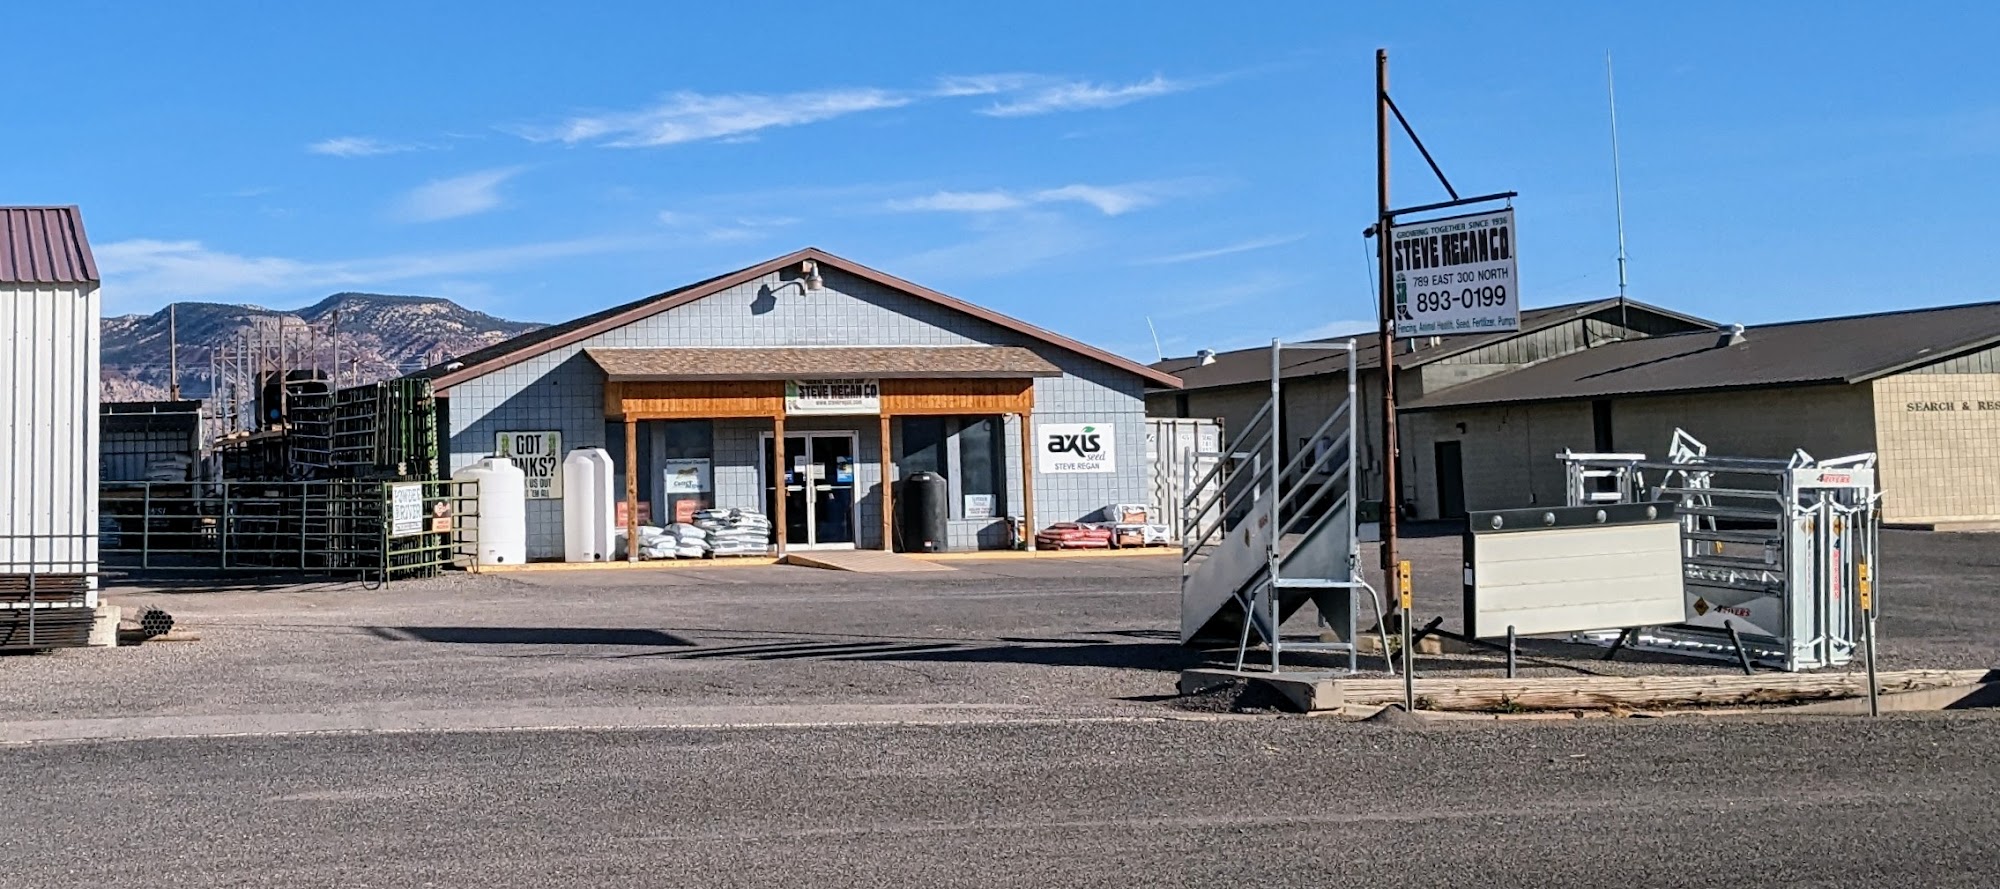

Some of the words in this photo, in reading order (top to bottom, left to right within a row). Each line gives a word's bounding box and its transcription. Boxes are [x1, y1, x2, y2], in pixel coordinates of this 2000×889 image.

[1396, 228, 1428, 239] GROWING
[1431, 223, 1466, 234] TOGETHER
[1468, 219, 1489, 230] SINCE
[1492, 216, 1508, 226] 1936
[1394, 235, 1439, 272] STEVE
[1441, 229, 1488, 266] REGAN
[1412, 275, 1429, 288] 789
[1432, 273, 1455, 286] EAST
[1457, 271, 1475, 284] 300
[1478, 267, 1509, 281] NORTH
[1416, 285, 1506, 313] 893-0199
[1498, 316, 1516, 327] Pumps
[799, 385, 829, 399] STEVE
[831, 385, 862, 399] REGAN
[1907, 402, 1954, 411] SEARCH
[1962, 401, 1970, 411] &
[516, 434, 542, 455] GOT
[1048, 433, 1101, 458] axis
[1086, 450, 1106, 461] seed
[511, 457, 557, 477] NKS?
[1054, 463, 1076, 471] STEVE
[1077, 462, 1100, 470] REGAN
